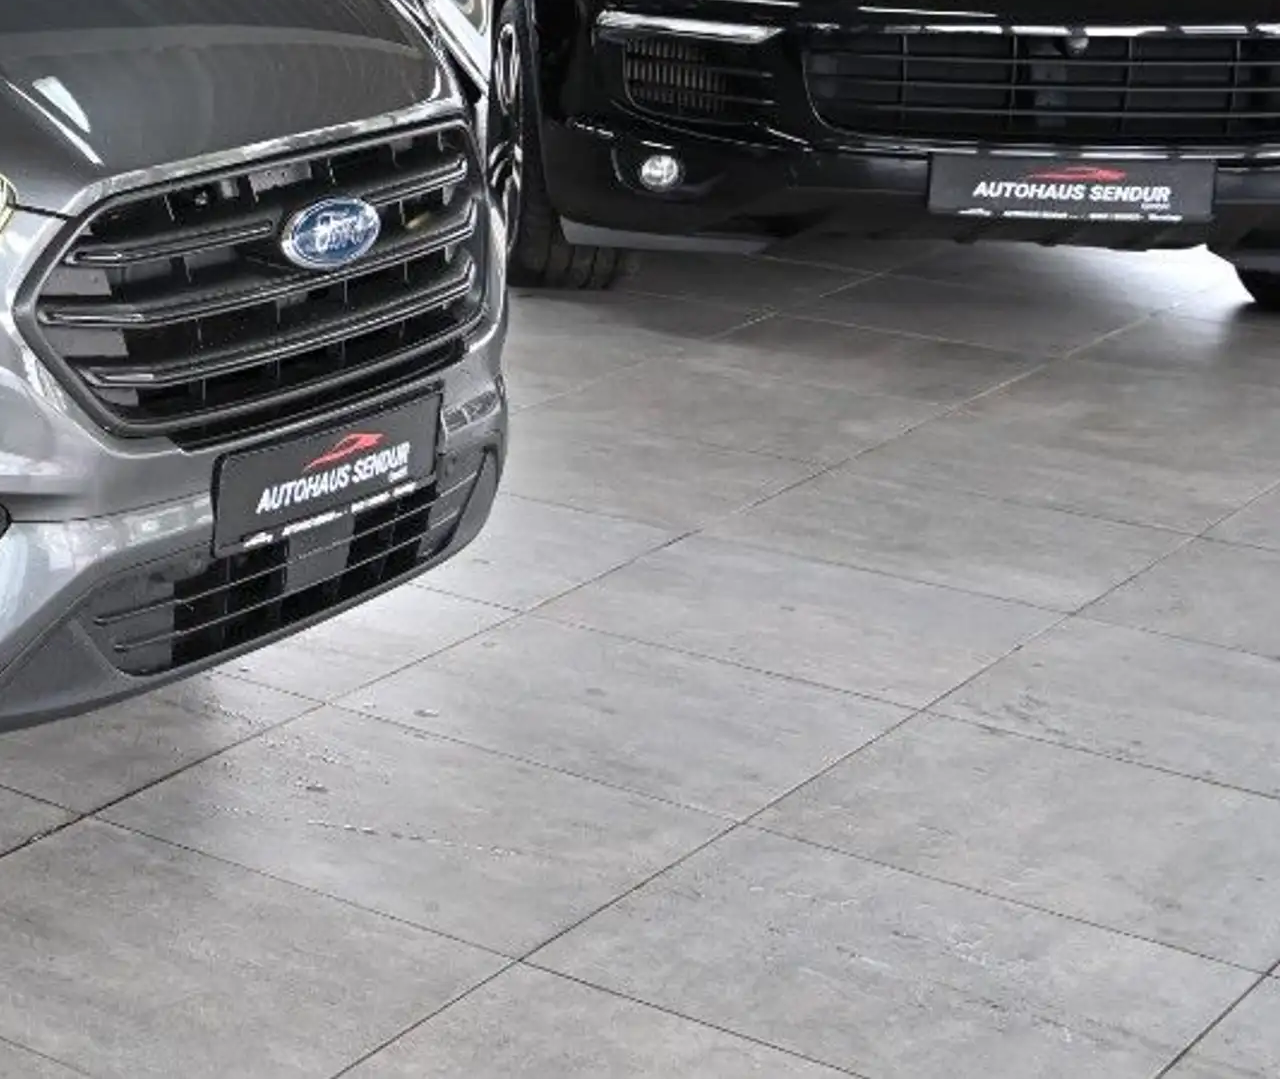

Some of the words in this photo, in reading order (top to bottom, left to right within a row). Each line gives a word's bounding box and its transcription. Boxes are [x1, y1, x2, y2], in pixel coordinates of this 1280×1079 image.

[973, 181, 1085, 201] AUTOHAUS
[1089, 186, 1171, 202] SENDUR
[255, 463, 352, 515] AUTOHAUS
[351, 441, 411, 483] SENDUR
